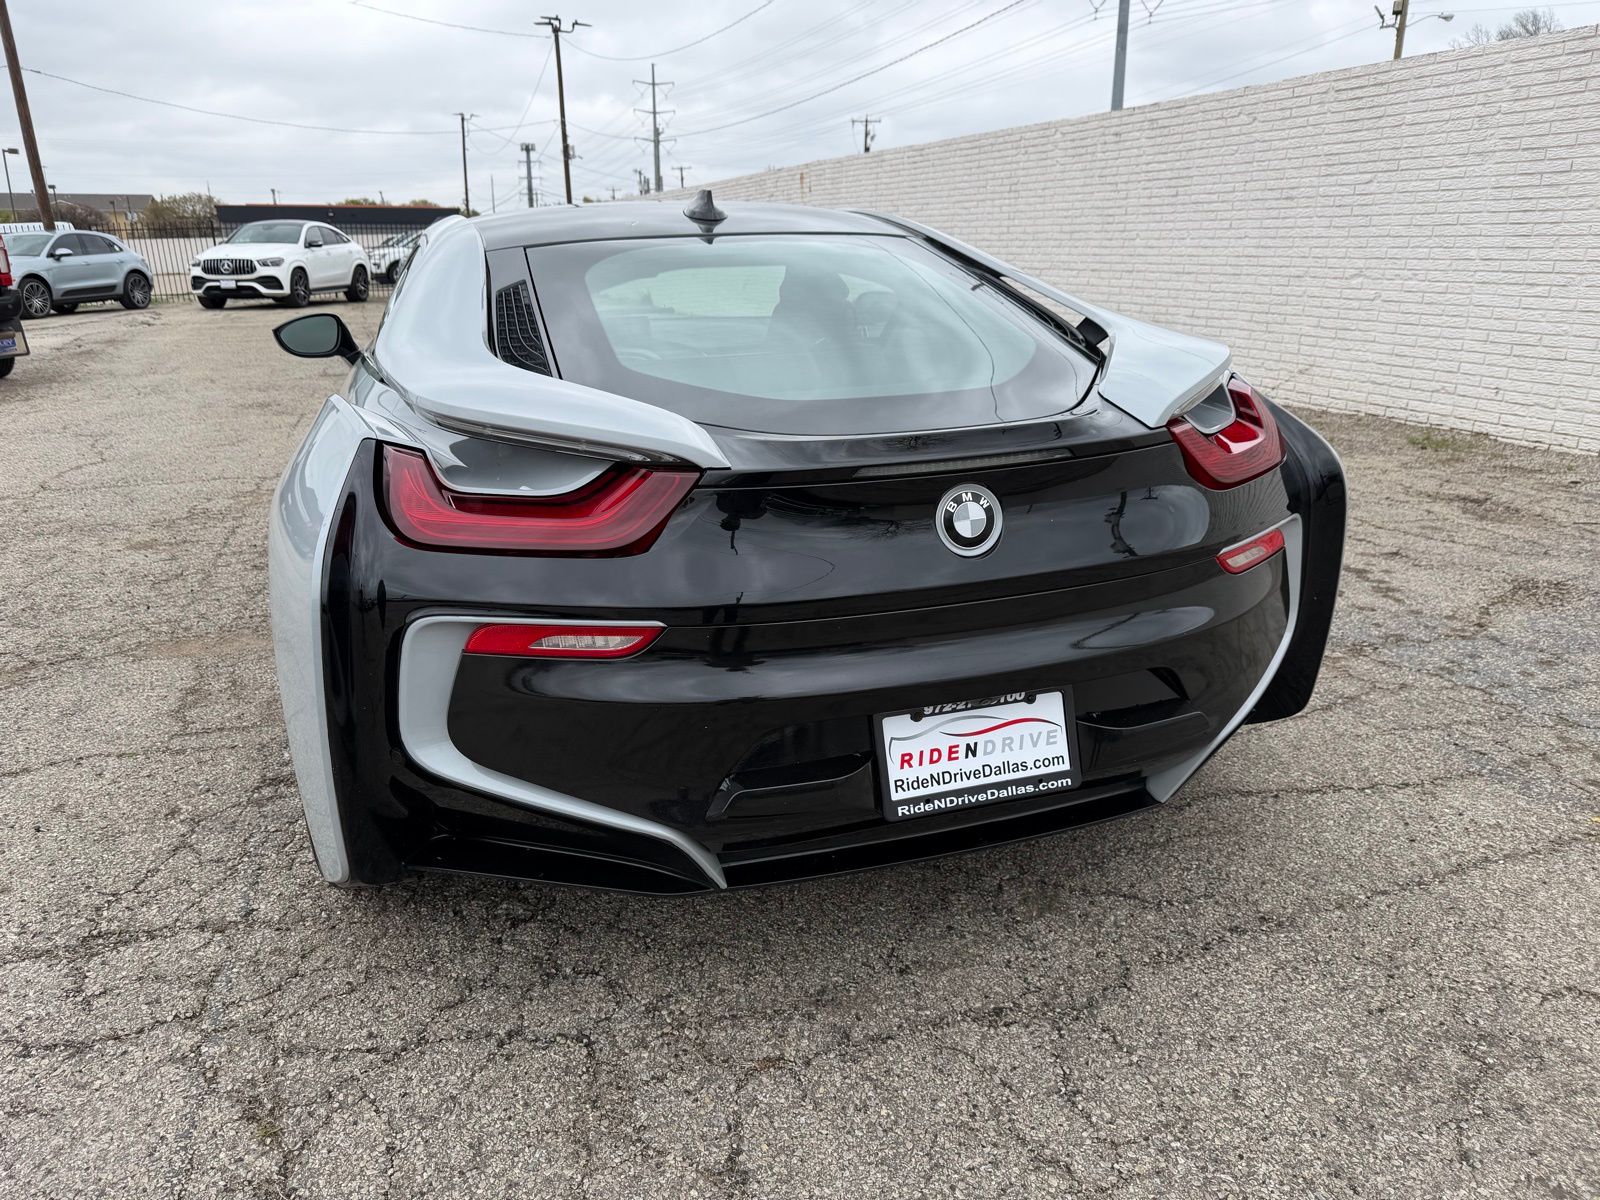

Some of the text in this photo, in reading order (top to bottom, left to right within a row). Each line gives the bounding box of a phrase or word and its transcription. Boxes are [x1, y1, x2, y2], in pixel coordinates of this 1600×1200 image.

[946, 492, 990, 513] BMW
[893, 754, 1065, 794] RideNDriveDallas.com
[897, 778, 1072, 817] RideNDriveDallas.com
